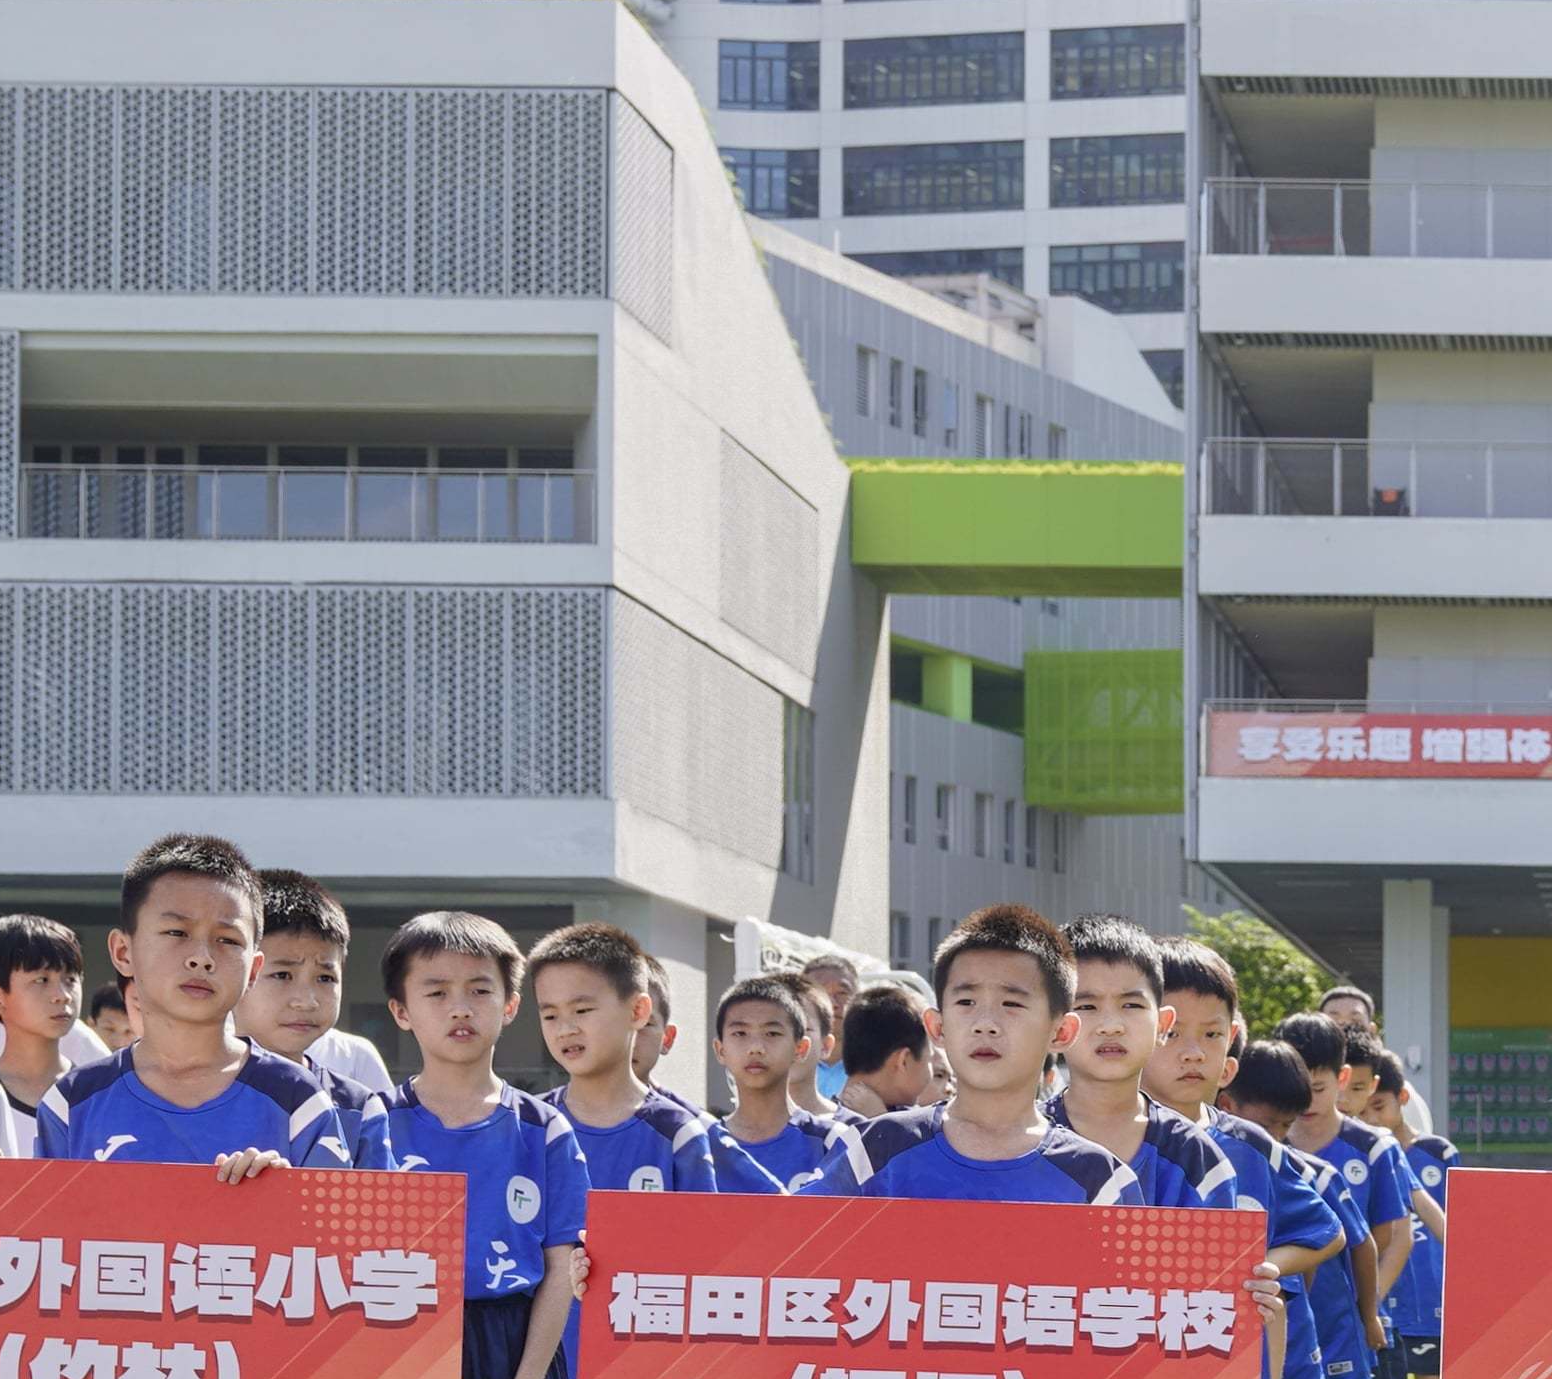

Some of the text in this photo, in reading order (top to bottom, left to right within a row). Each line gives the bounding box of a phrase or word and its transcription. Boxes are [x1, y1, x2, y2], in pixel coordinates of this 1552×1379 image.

[608, 1272, 1237, 1353] 福田区外国语学校
